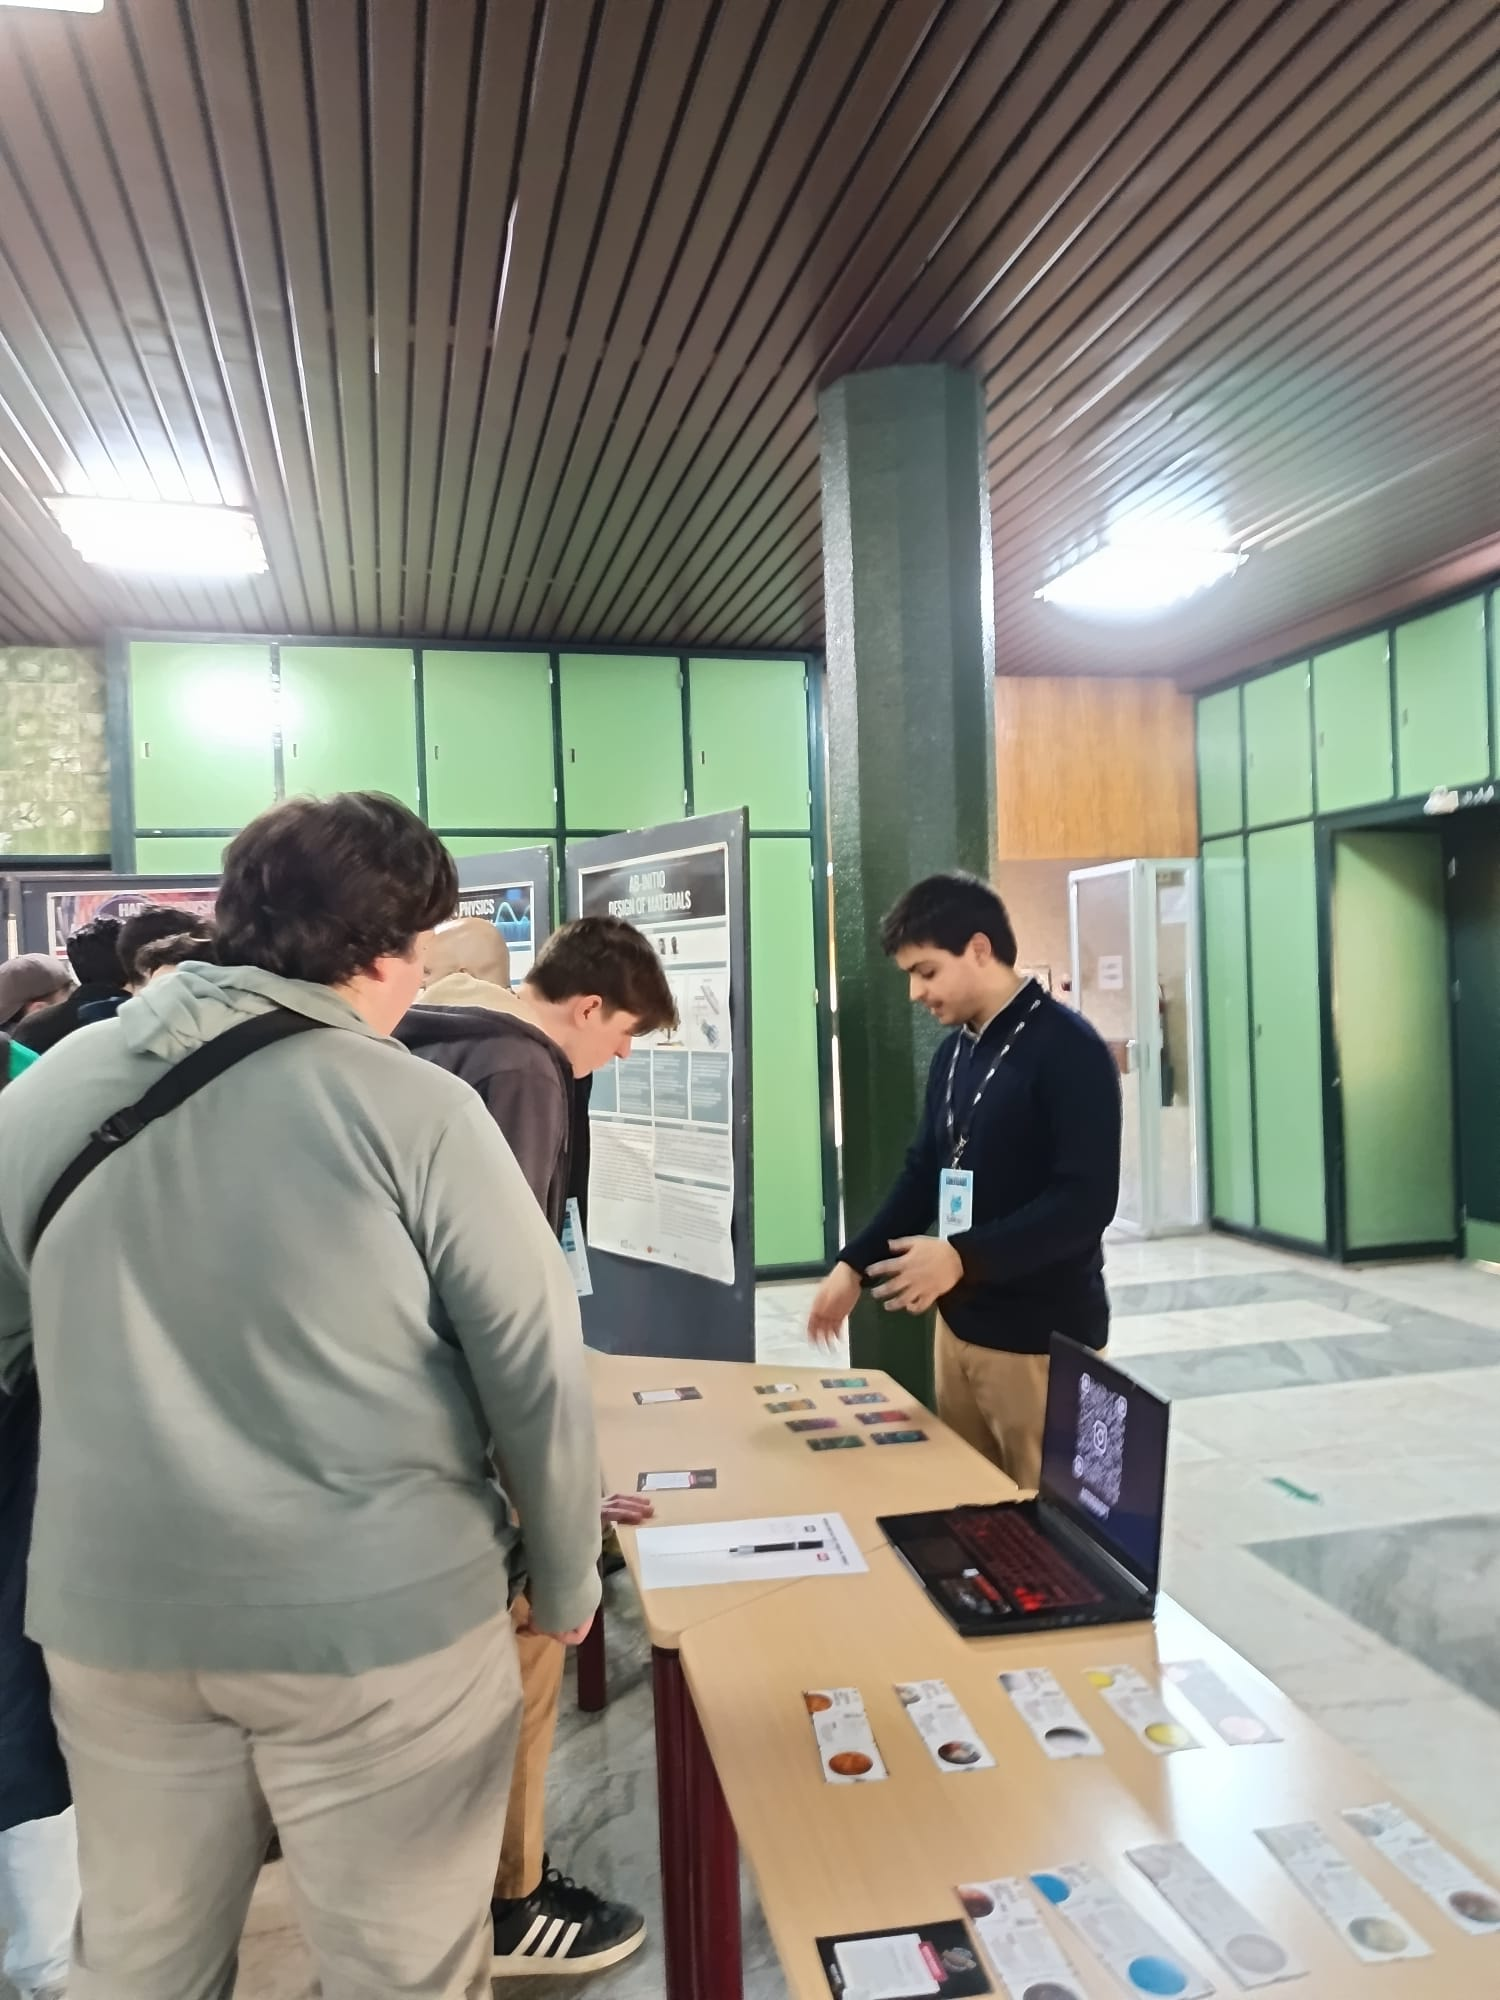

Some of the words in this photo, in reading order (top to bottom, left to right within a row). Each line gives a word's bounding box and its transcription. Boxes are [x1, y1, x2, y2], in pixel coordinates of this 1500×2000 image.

[629, 870, 665, 892] AB-INITIO
[459, 899, 495, 917] PHYSICS
[608, 898, 635, 918] DESIGN
[636, 897, 647, 914] OF
[648, 890, 691, 913] MATERIALS
